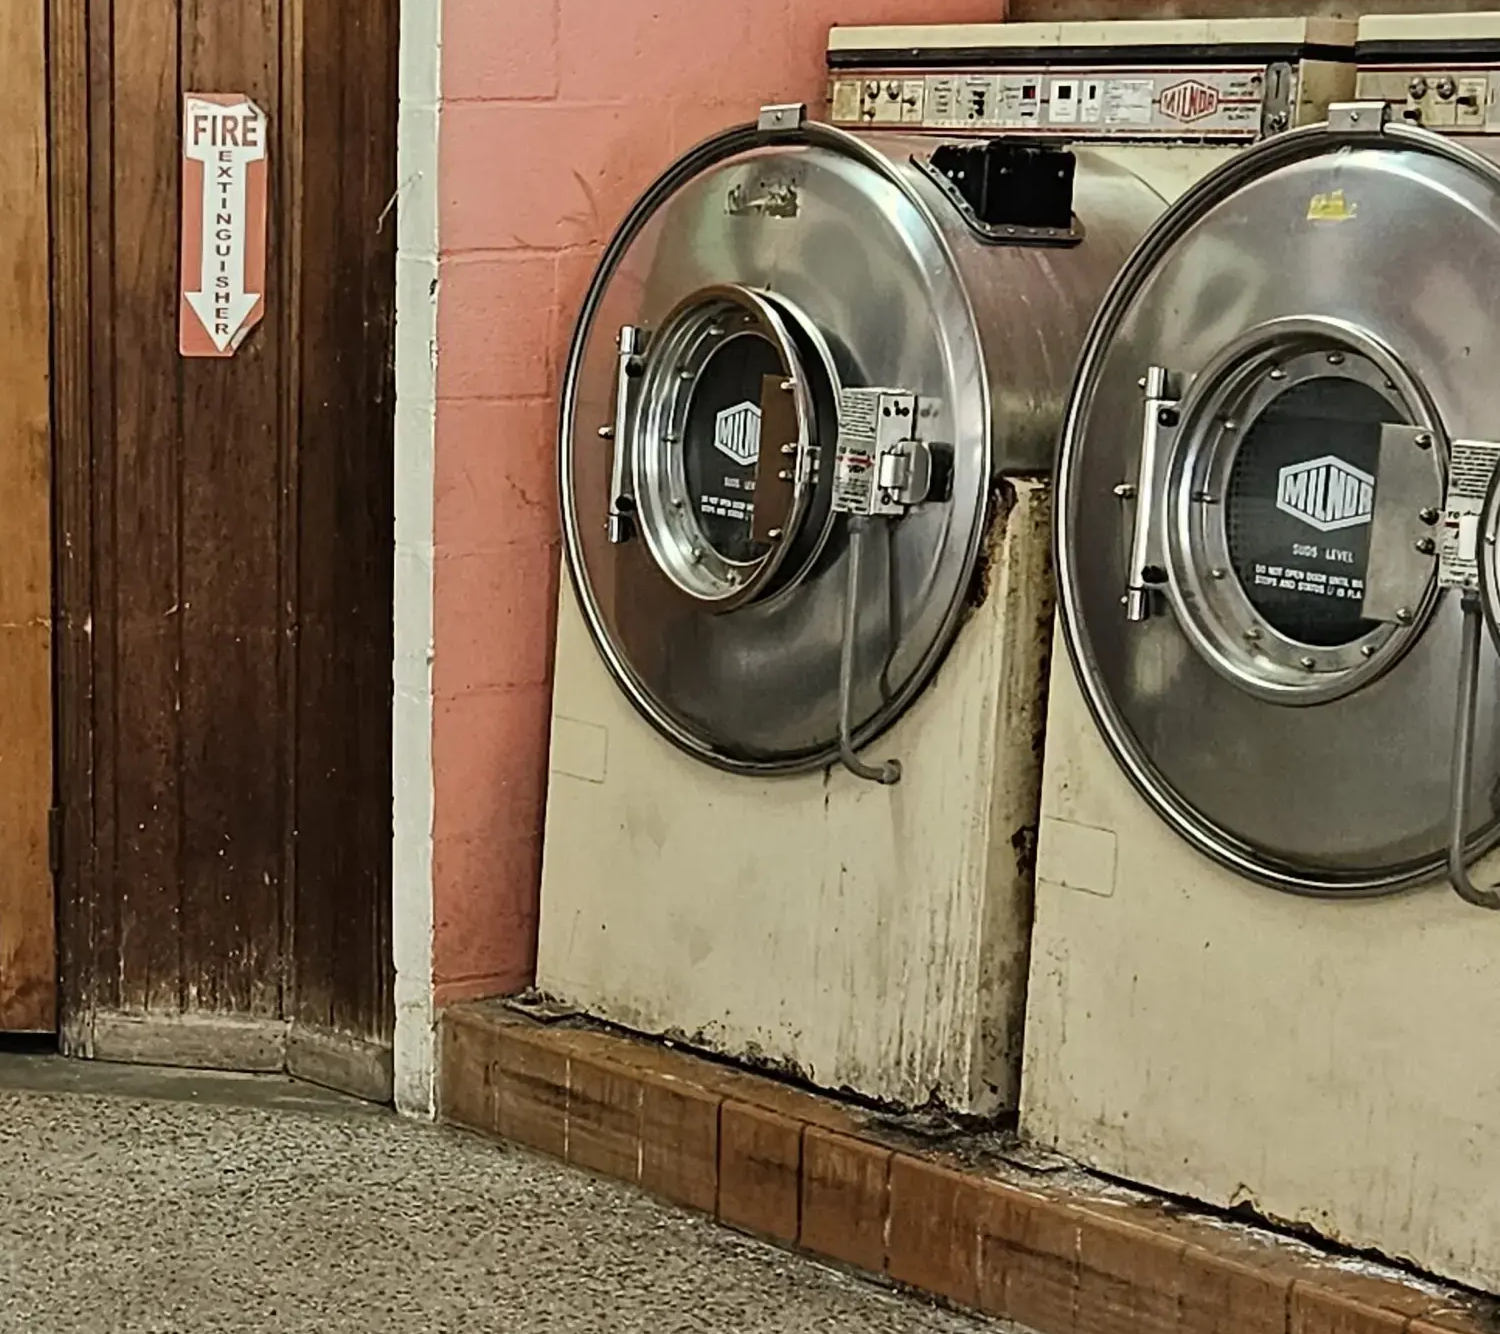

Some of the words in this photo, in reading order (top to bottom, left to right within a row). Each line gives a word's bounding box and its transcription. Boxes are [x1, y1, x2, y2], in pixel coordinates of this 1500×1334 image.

[194, 115, 257, 146] FIRE
[215, 151, 233, 335] EXTINGUISHER
[1285, 466, 1373, 522] MILNOR
[1326, 549, 1354, 563] LEVEL
